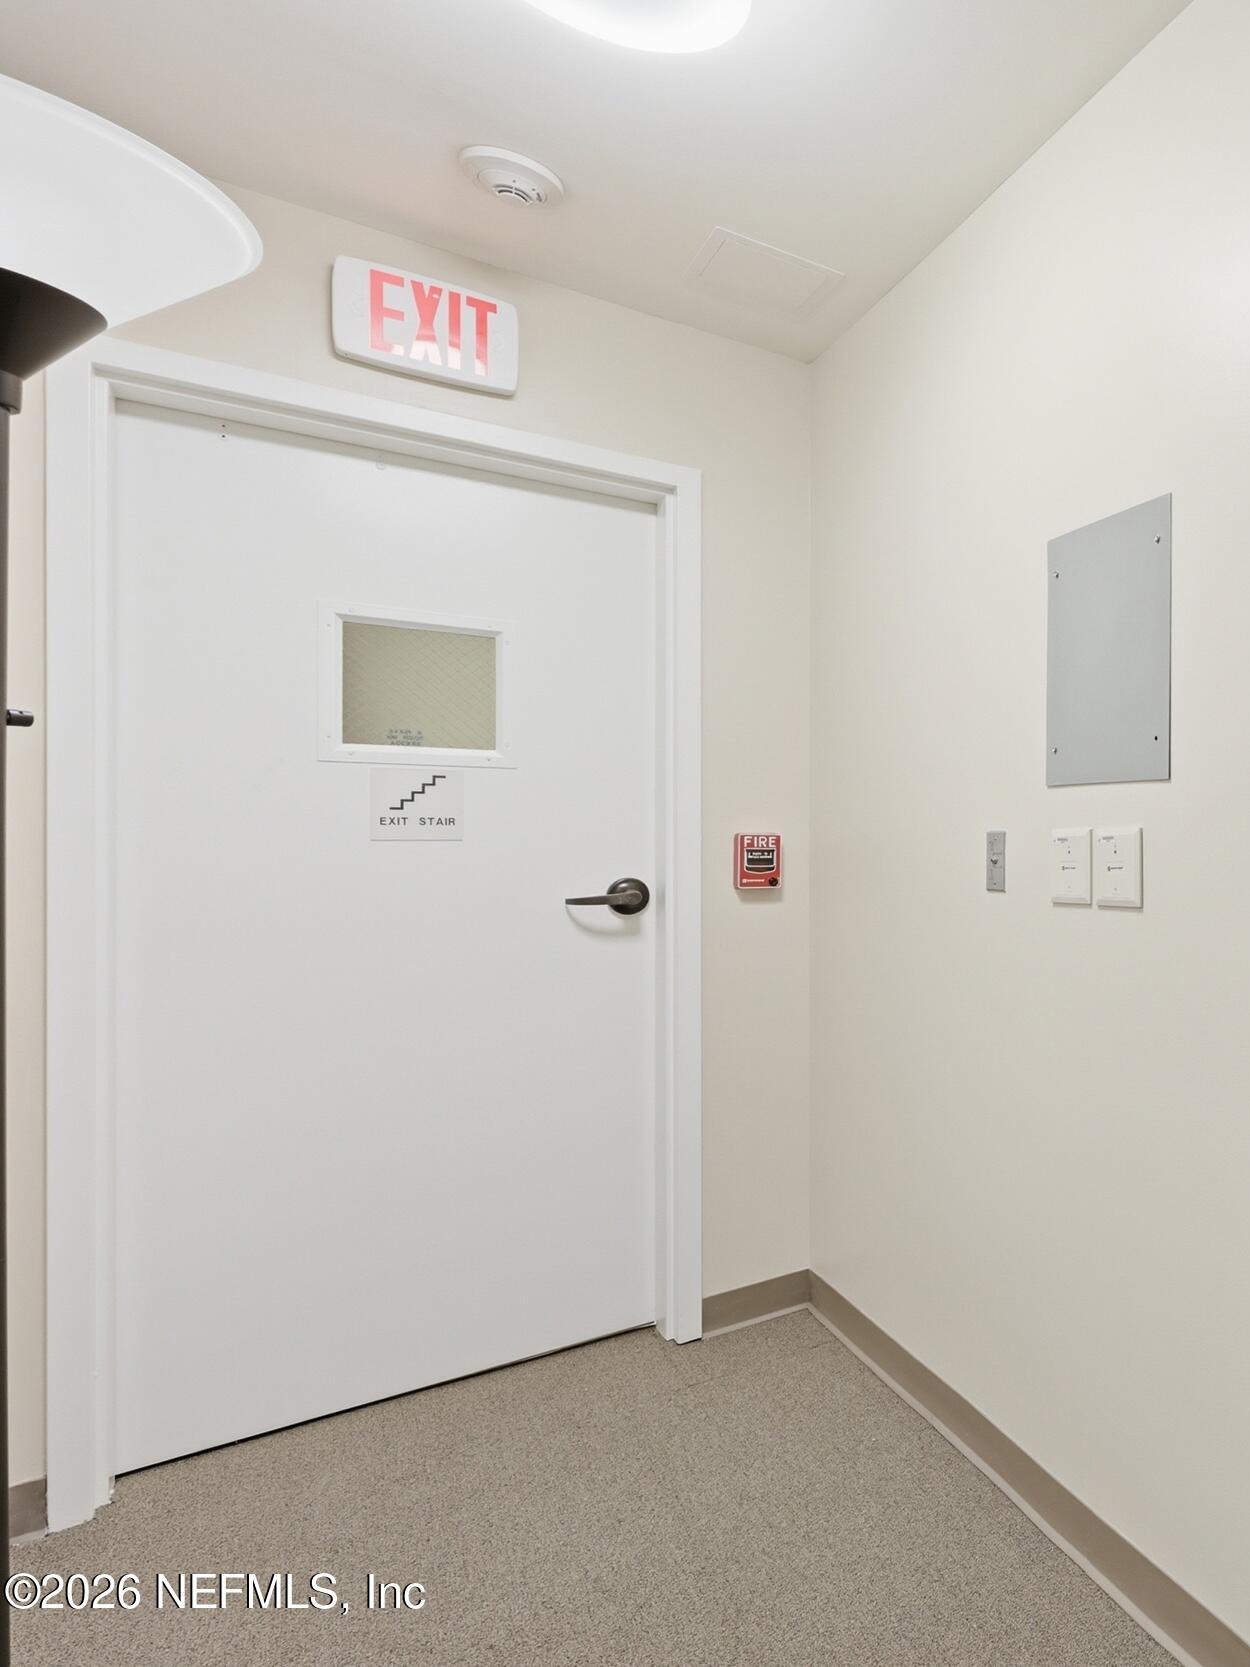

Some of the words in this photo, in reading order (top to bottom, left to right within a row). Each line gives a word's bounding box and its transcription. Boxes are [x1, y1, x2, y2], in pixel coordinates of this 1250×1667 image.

[369, 269, 497, 377] EXIT
[379, 816, 408, 826] EXIT
[419, 817, 456, 826] STAIR
[744, 836, 776, 848] FIRE
